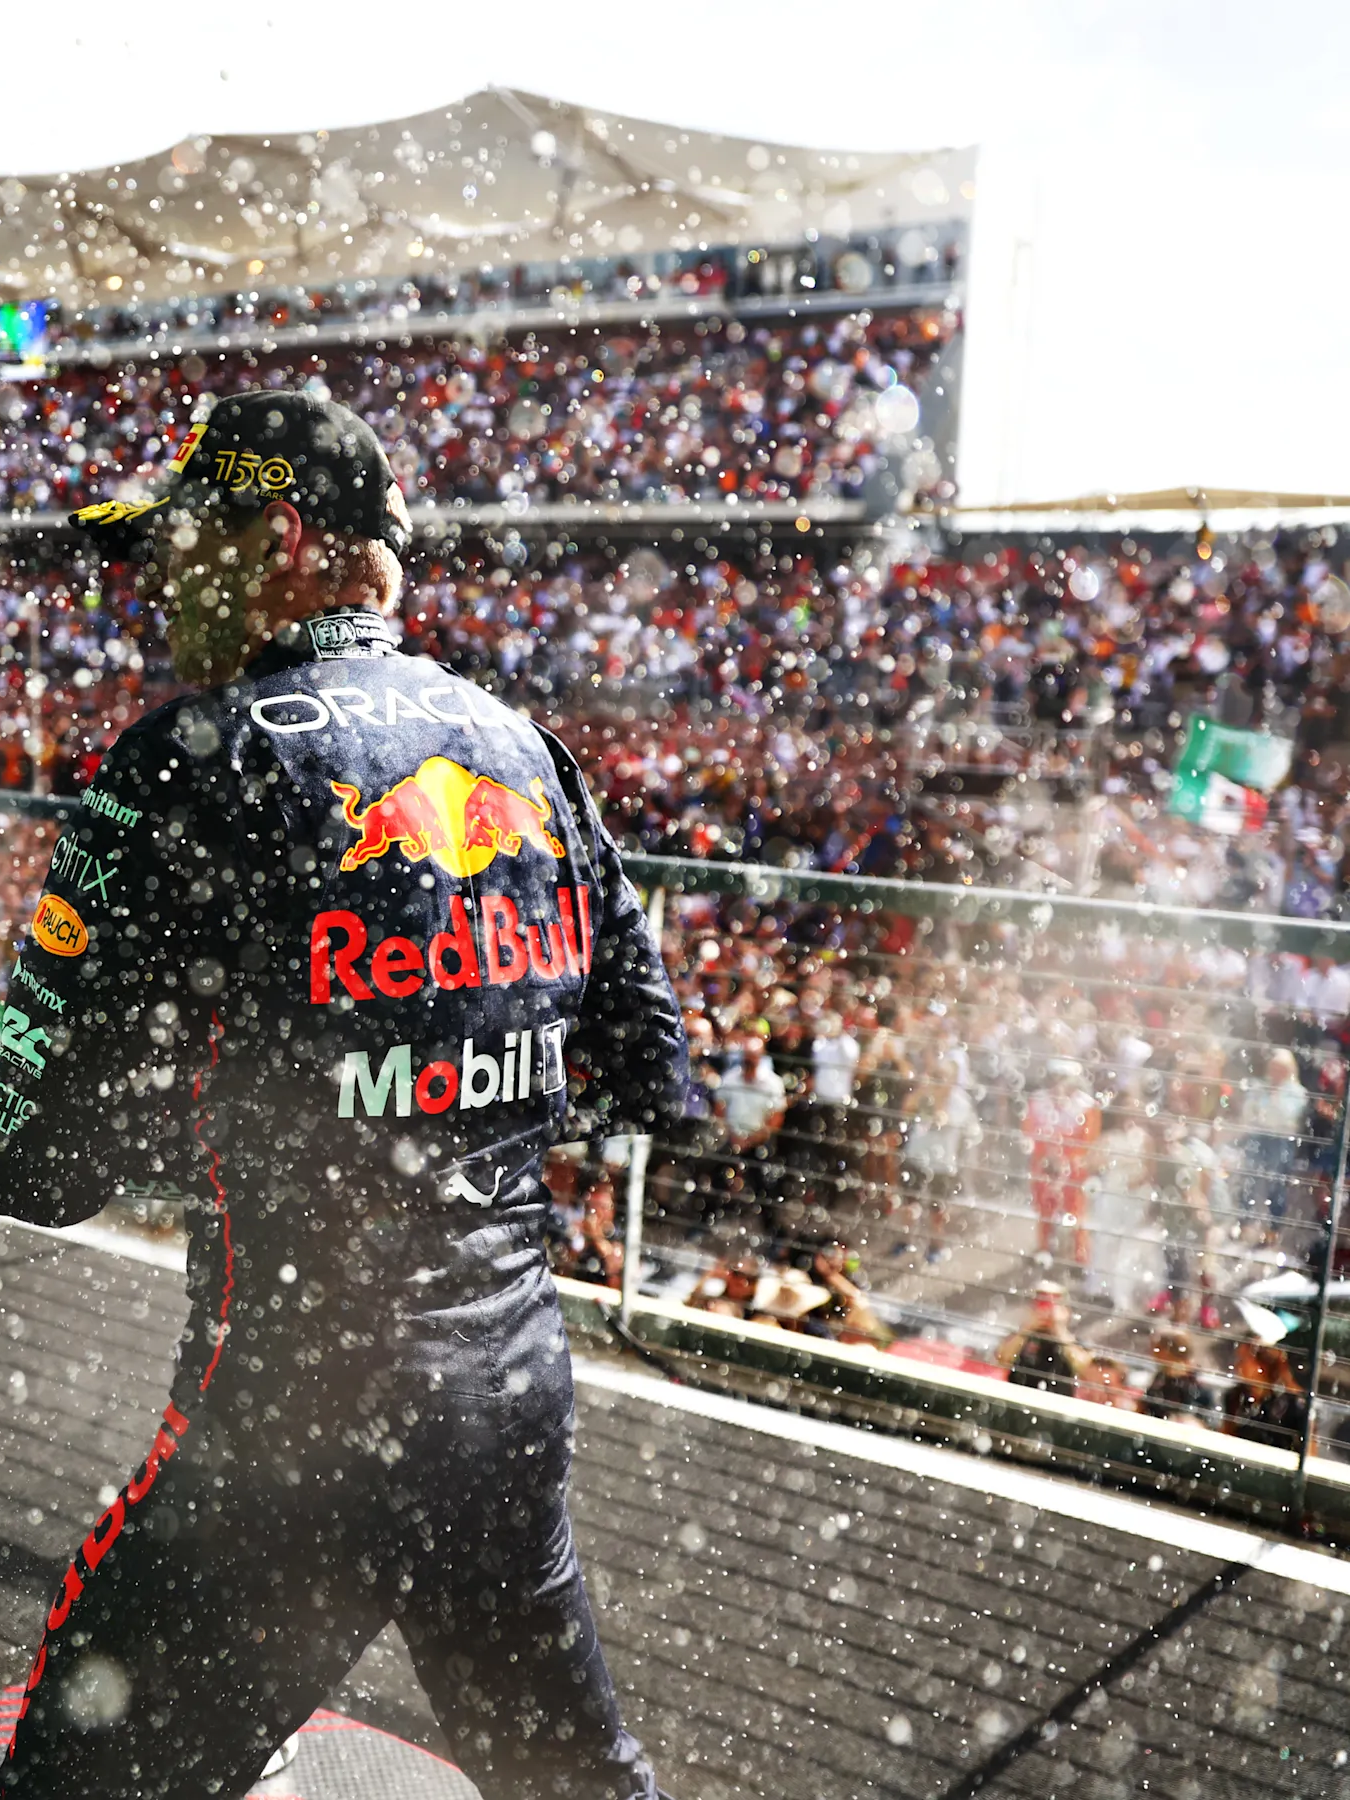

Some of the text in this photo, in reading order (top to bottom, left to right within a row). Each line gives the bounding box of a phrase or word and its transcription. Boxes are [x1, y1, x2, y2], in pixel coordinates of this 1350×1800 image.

[215, 450, 293, 491] 150
[254, 489, 284, 501] YEARS
[317, 623, 351, 644] FIA
[41, 908, 80, 949] RAUCH
[310, 886, 591, 1004] Red Bull
[337, 1029, 532, 1119] Mobil
